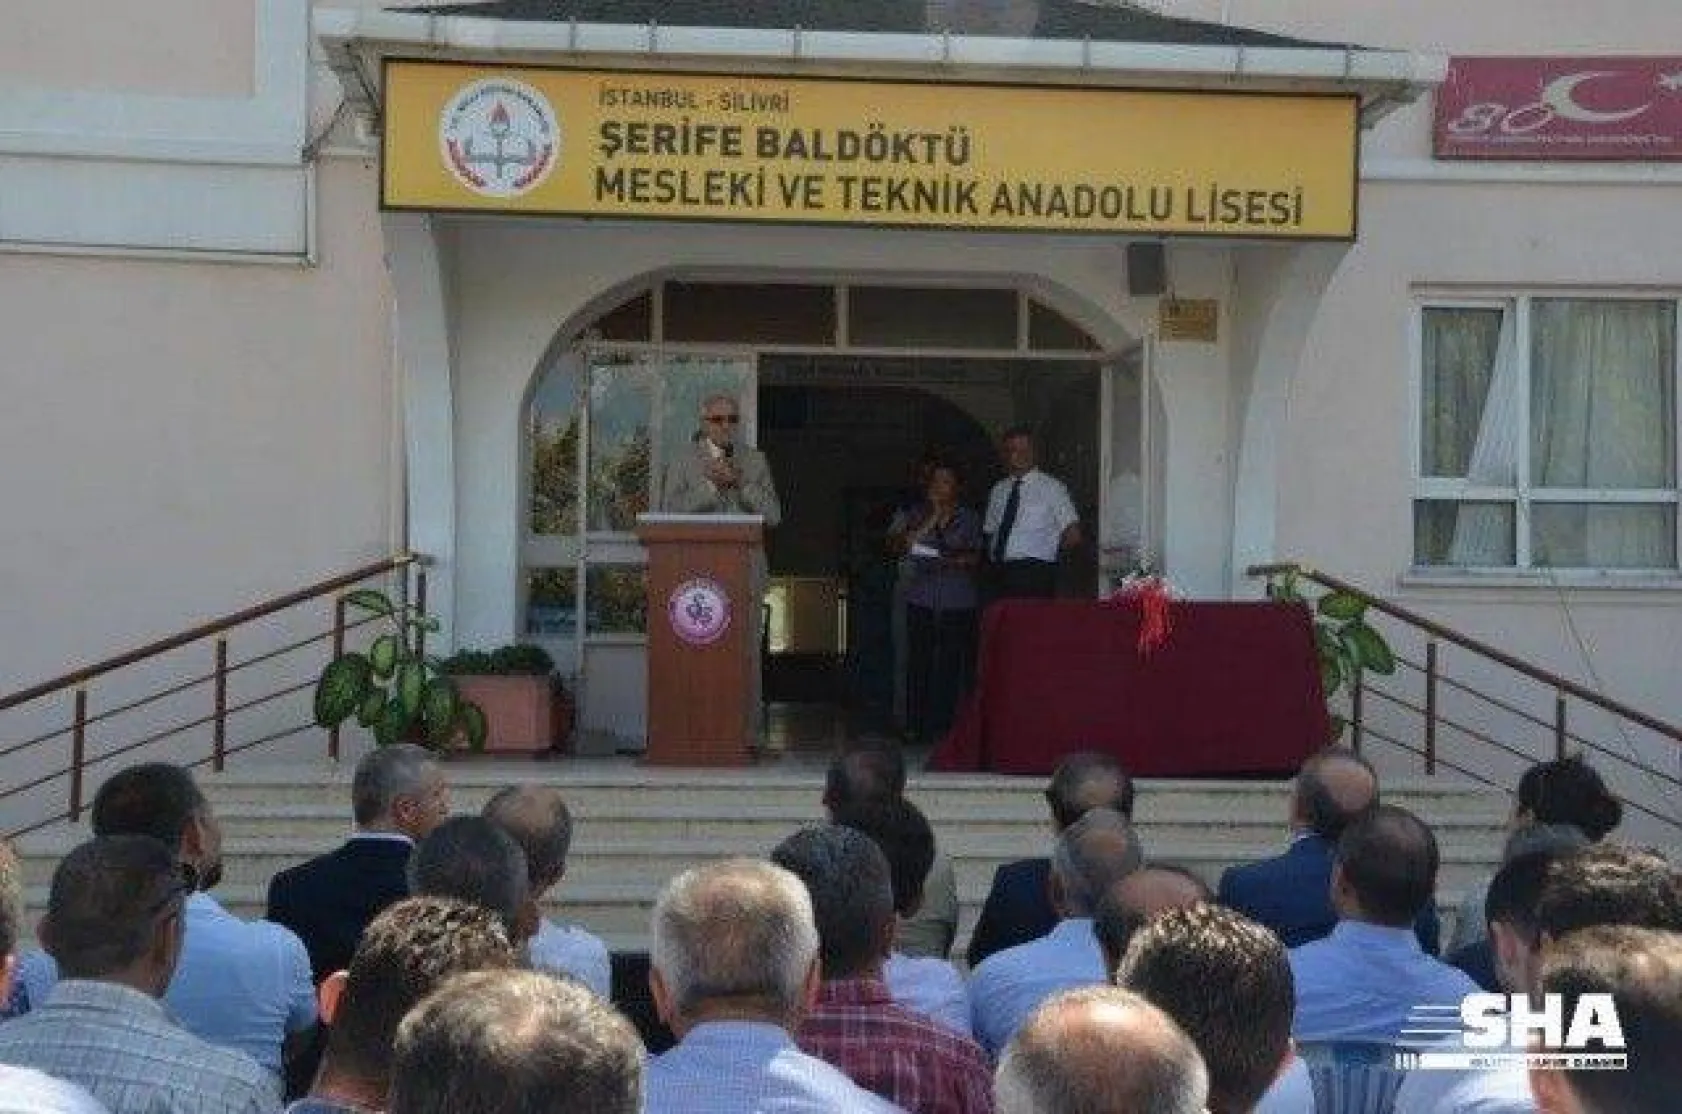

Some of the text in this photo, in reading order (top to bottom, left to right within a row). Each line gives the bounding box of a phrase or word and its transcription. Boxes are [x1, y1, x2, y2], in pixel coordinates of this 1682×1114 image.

[599, 88, 699, 108] İSTANBUL
[719, 91, 788, 113] SİLİVRİ
[599, 116, 970, 166] ŞERİFE BALDÖKTÜ
[596, 165, 1303, 226] MESLEKİ VE TEKNİK ANADOLU LİSESİ
